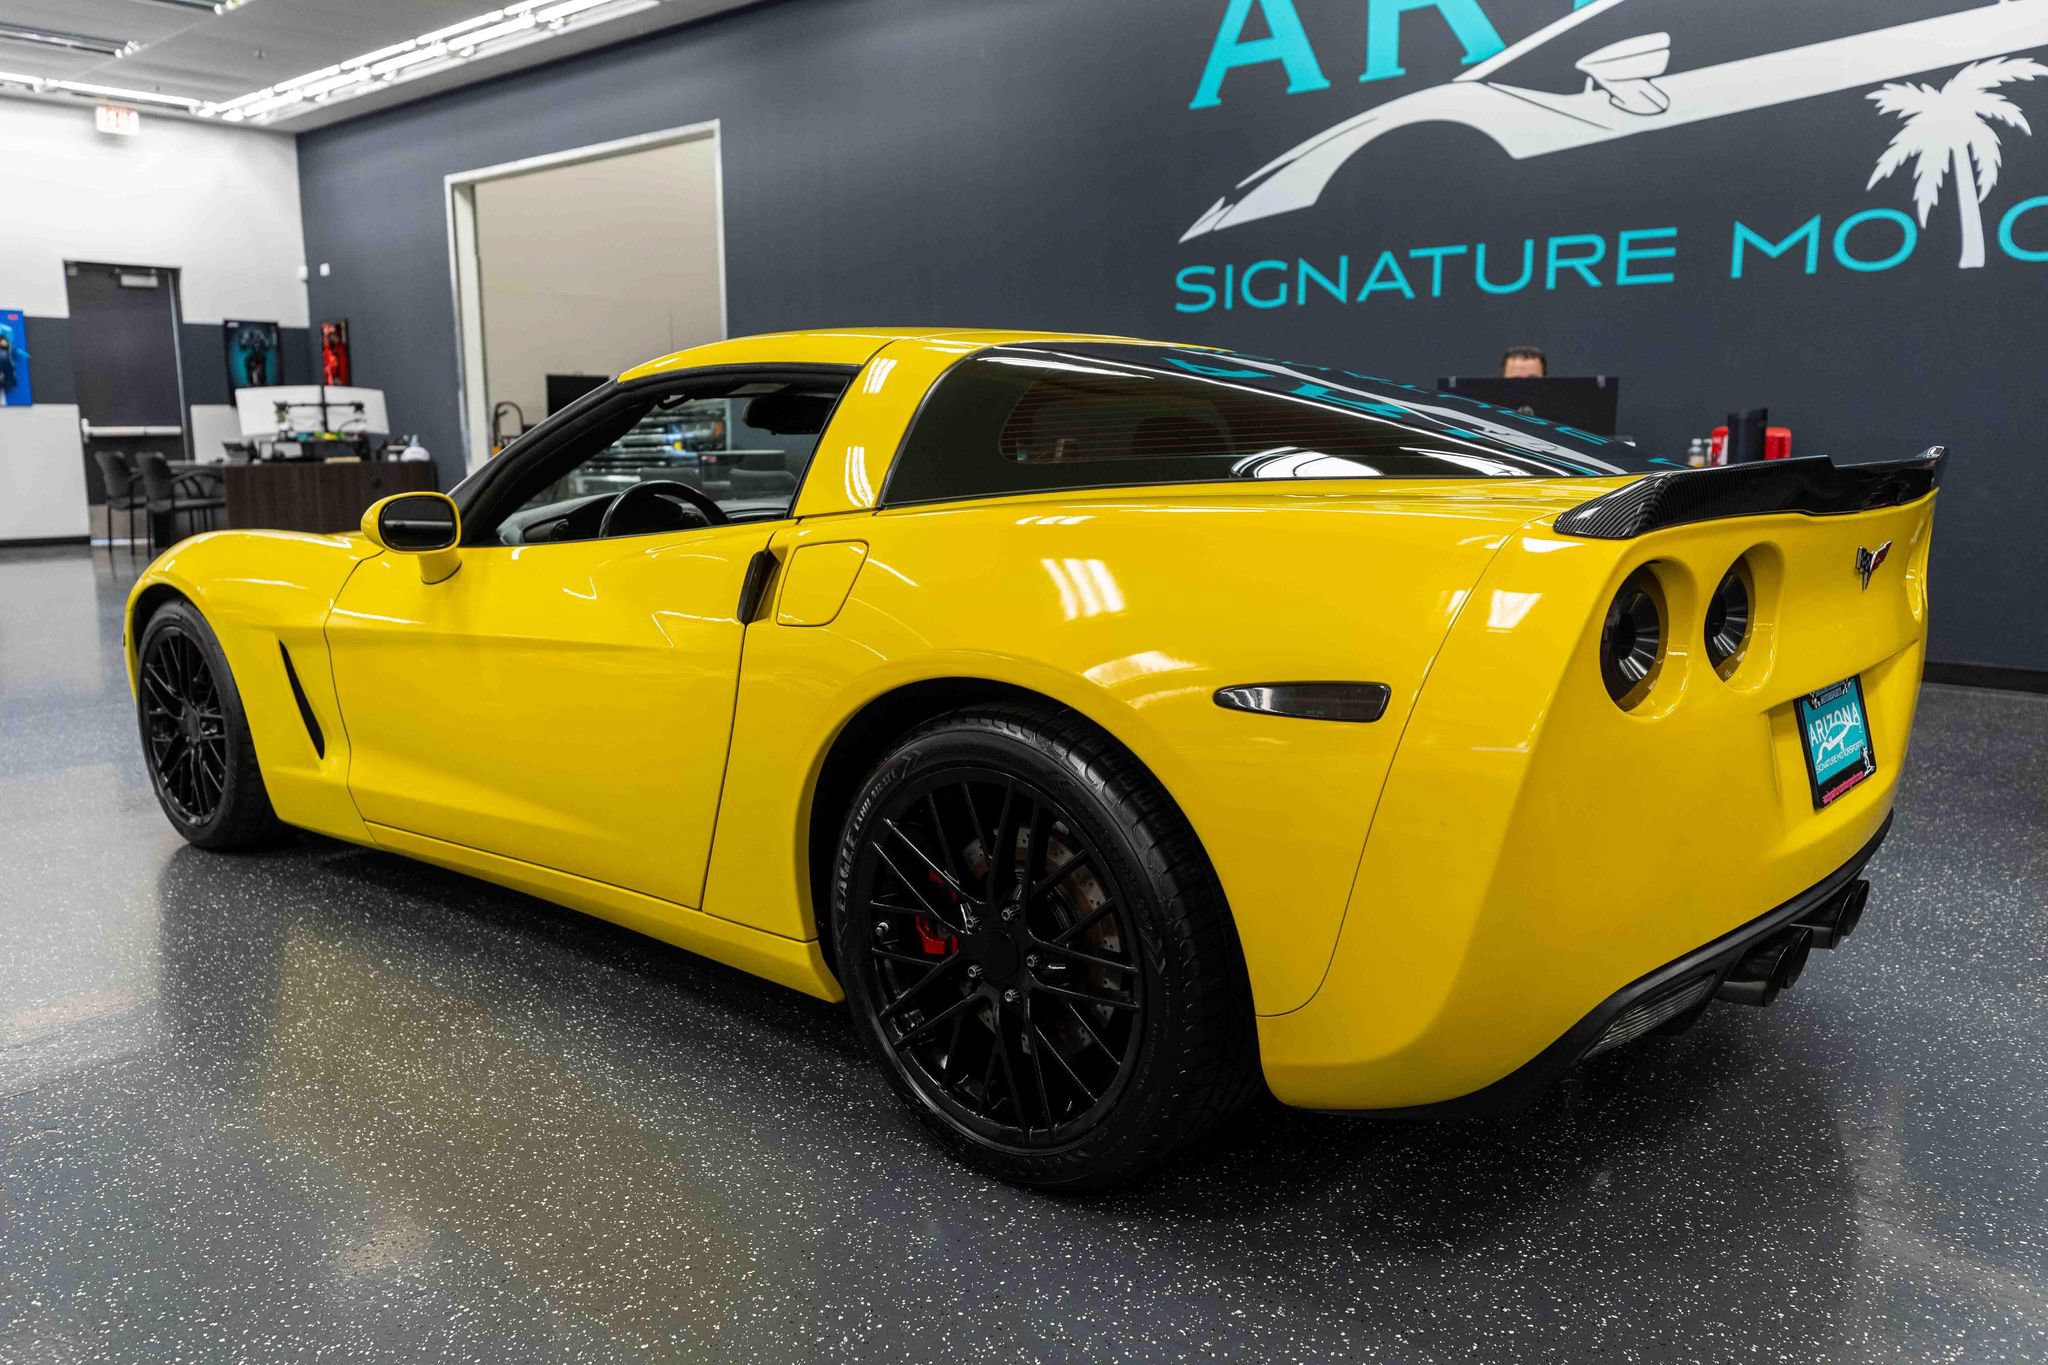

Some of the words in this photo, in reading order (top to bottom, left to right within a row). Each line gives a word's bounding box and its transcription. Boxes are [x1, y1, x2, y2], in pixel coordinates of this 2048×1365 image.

[1175, 227, 1677, 313] SIGNATURE
[1809, 702, 1861, 747] ARIZONA
[837, 828, 857, 912] EAGLE
